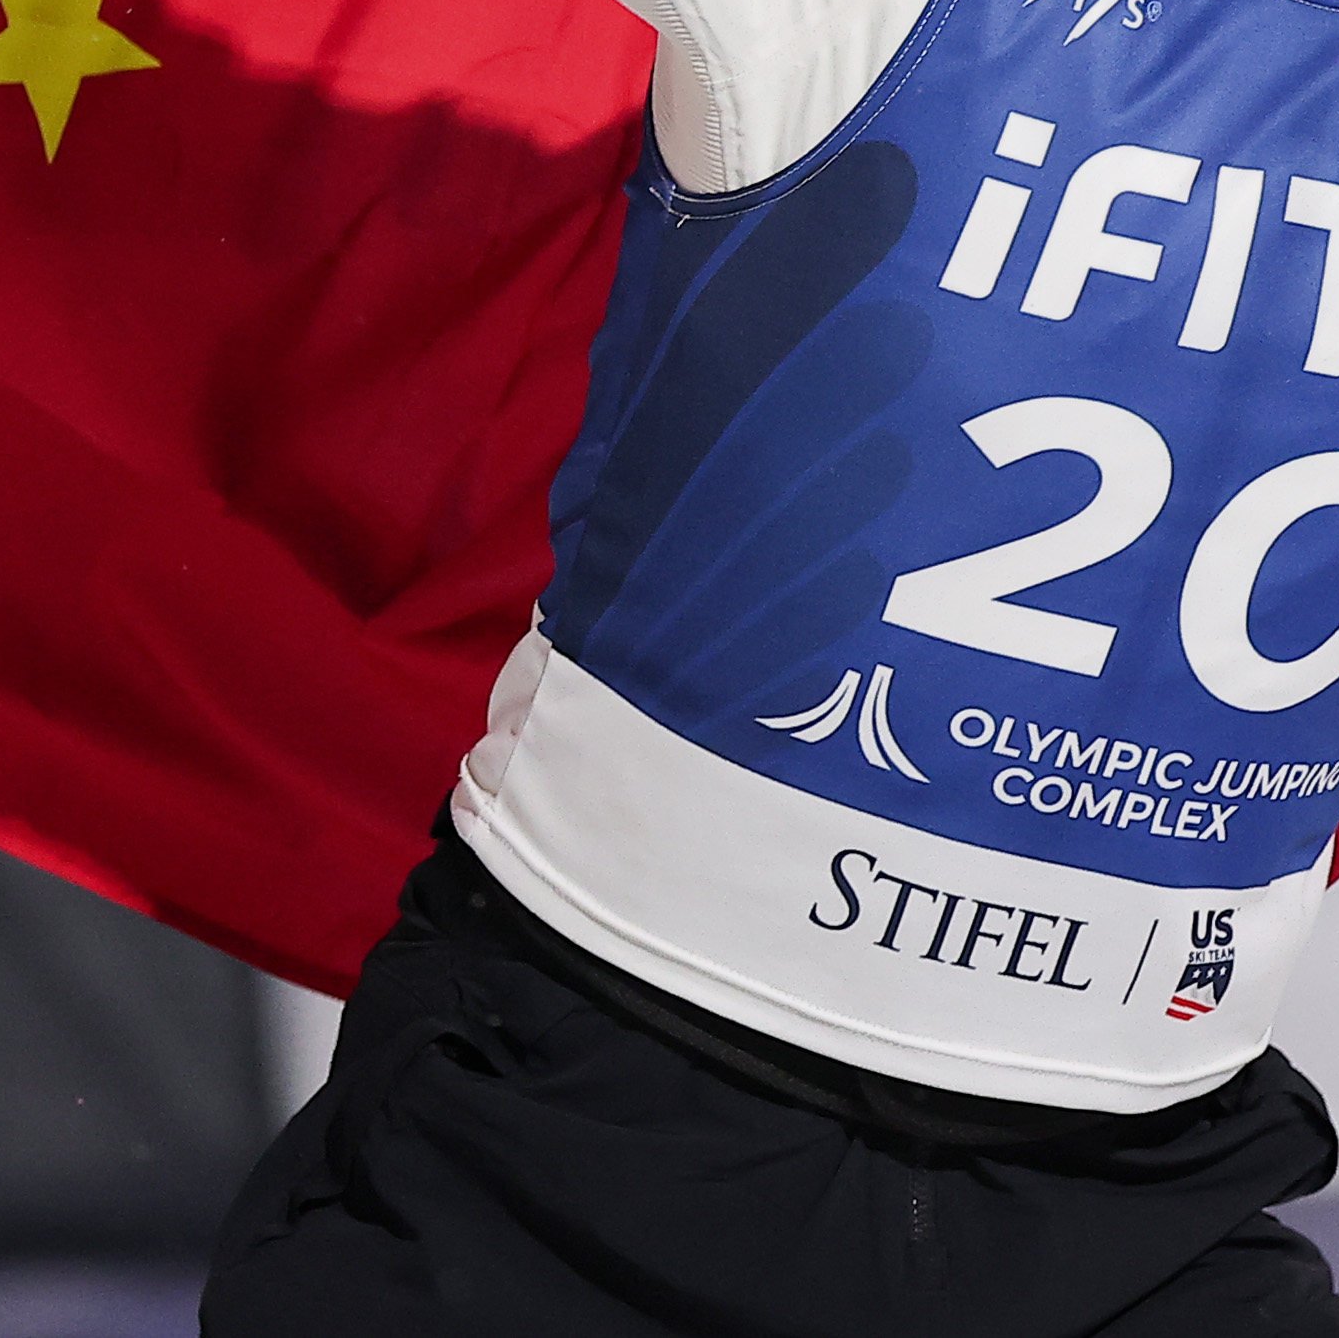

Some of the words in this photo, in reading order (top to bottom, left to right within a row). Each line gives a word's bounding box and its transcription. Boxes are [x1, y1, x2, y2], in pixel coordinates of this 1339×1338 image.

[949, 707, 1193, 790] OLYMPIC
[992, 766, 1239, 843] COMPLEX
[809, 848, 1092, 991] STIFEL
[1188, 951, 1206, 963] SKI
[1207, 947, 1235, 961] TEAM
[1190, 908, 1235, 949] US
